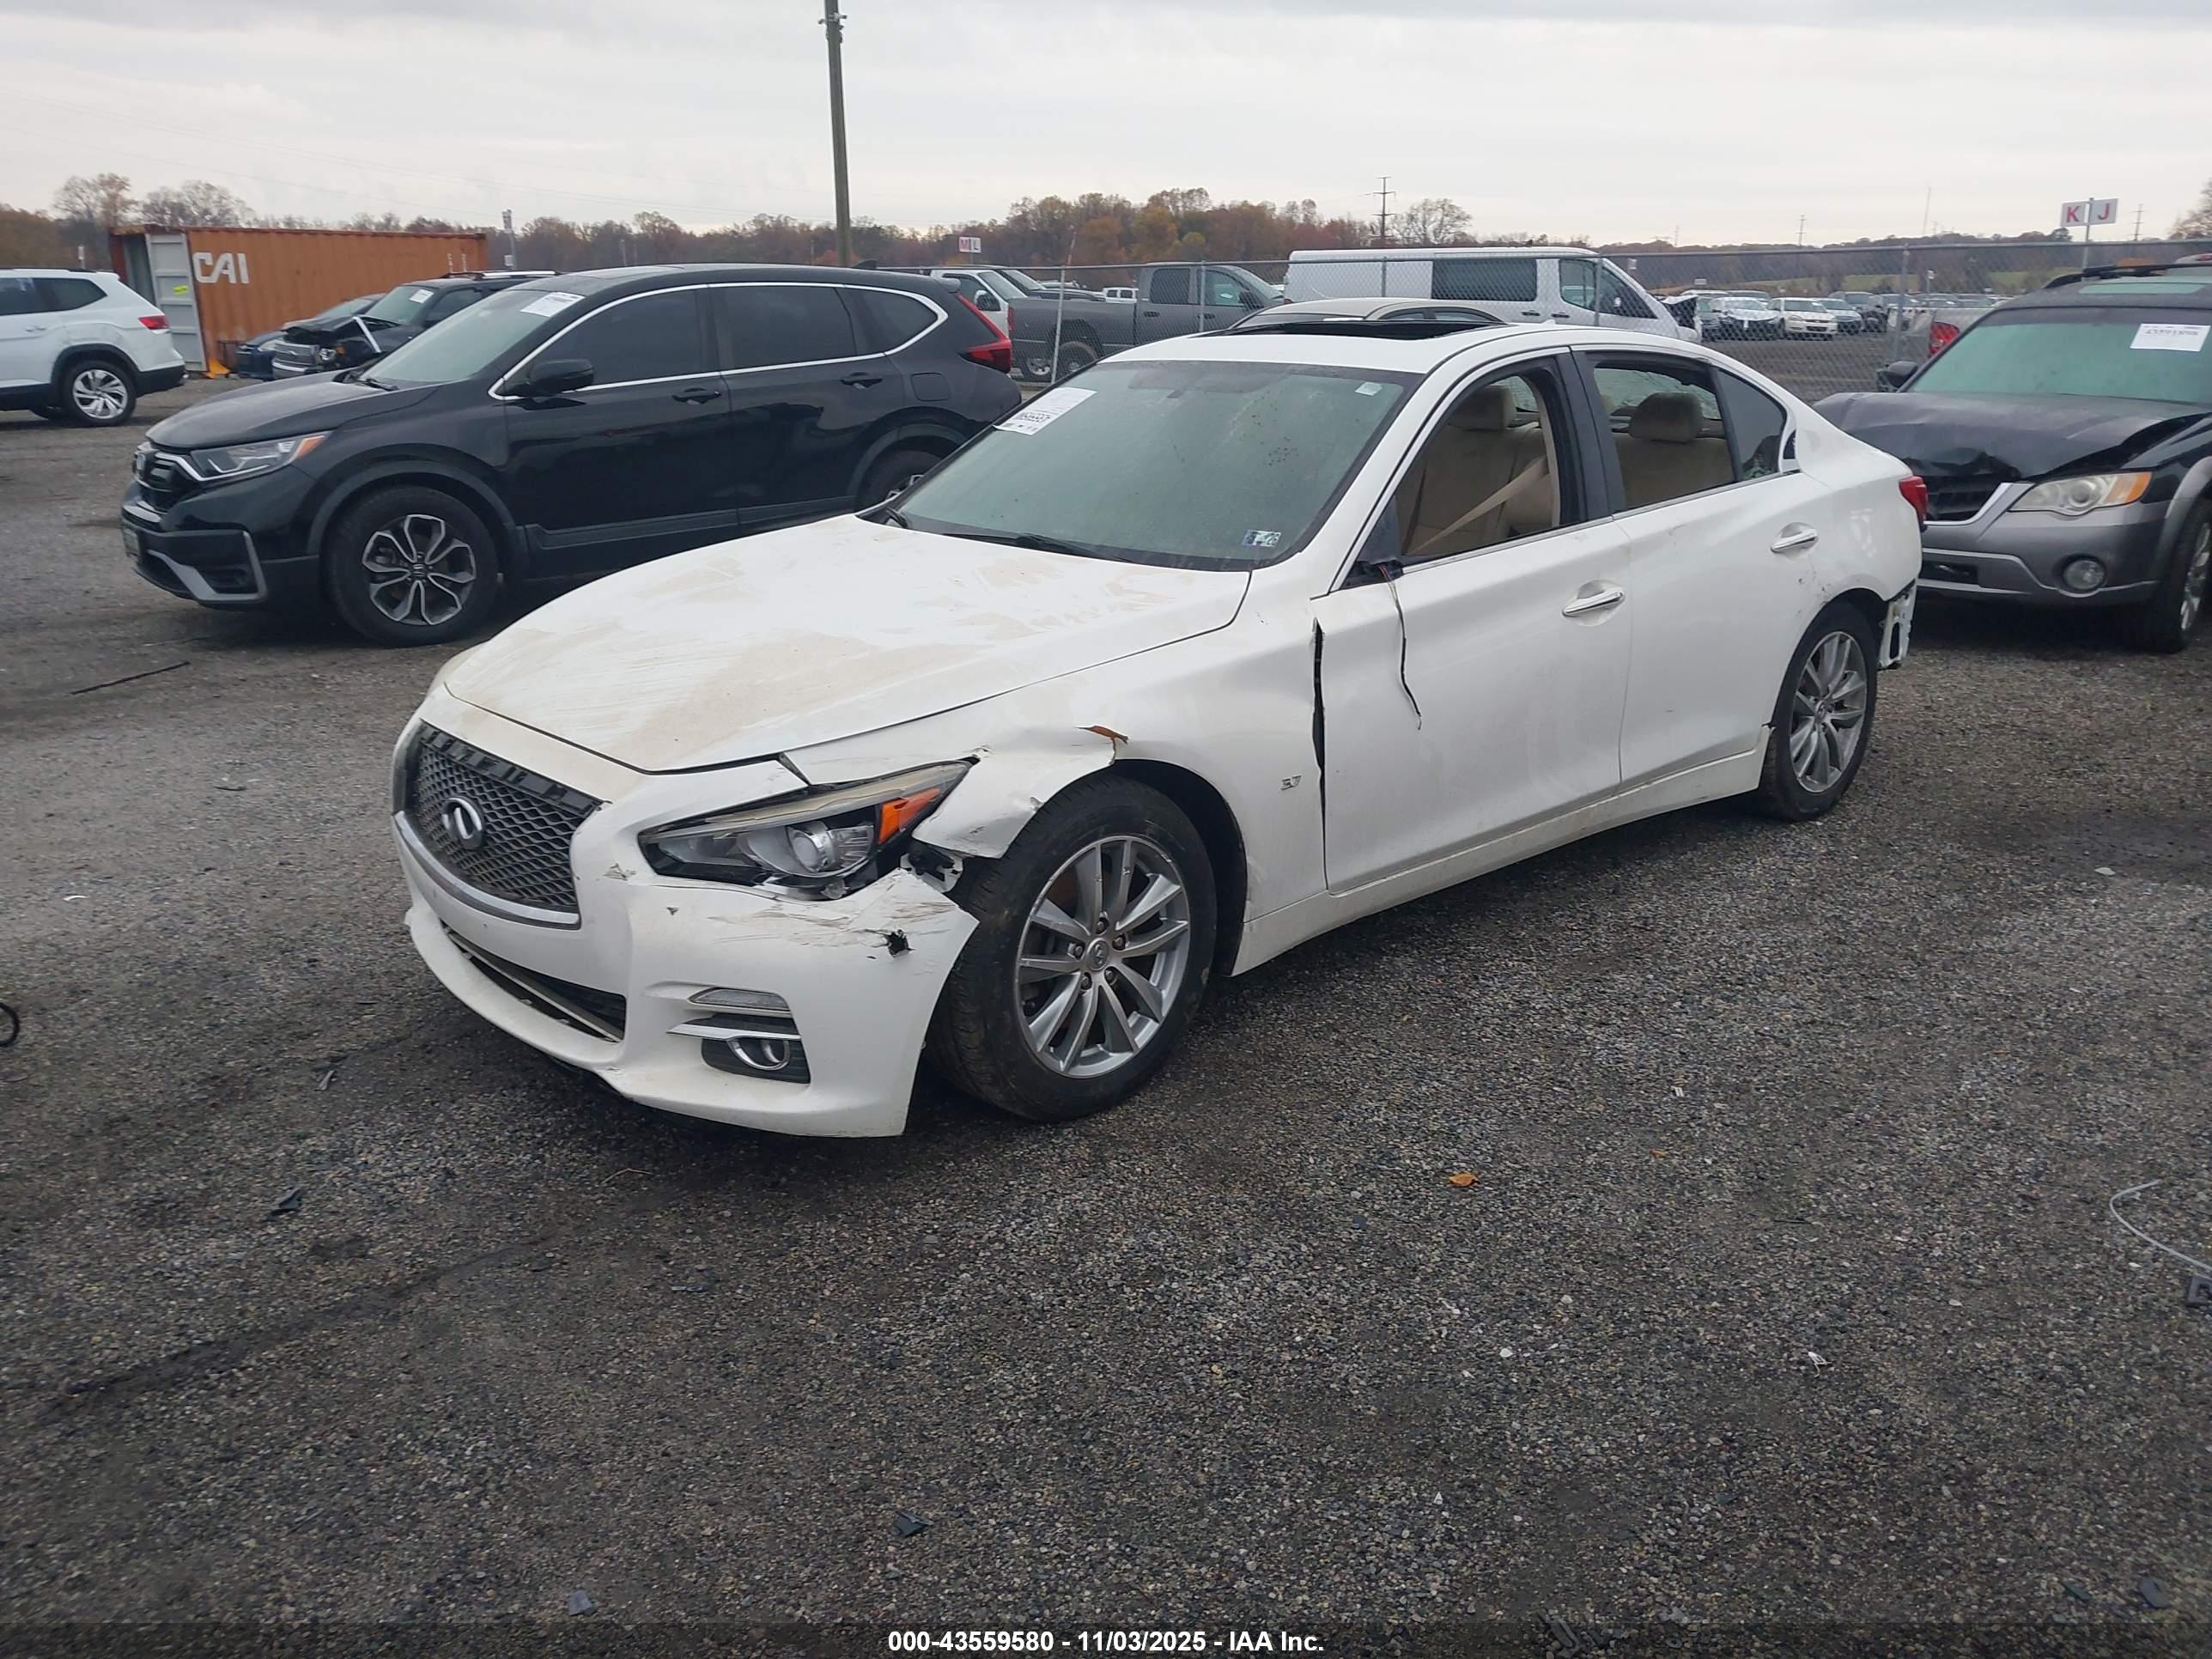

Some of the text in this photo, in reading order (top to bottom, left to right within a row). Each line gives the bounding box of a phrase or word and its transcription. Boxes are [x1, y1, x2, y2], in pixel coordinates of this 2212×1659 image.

[2067, 205, 2081, 222] K
[2098, 203, 2110, 220] J
[191, 252, 250, 284] CAI
